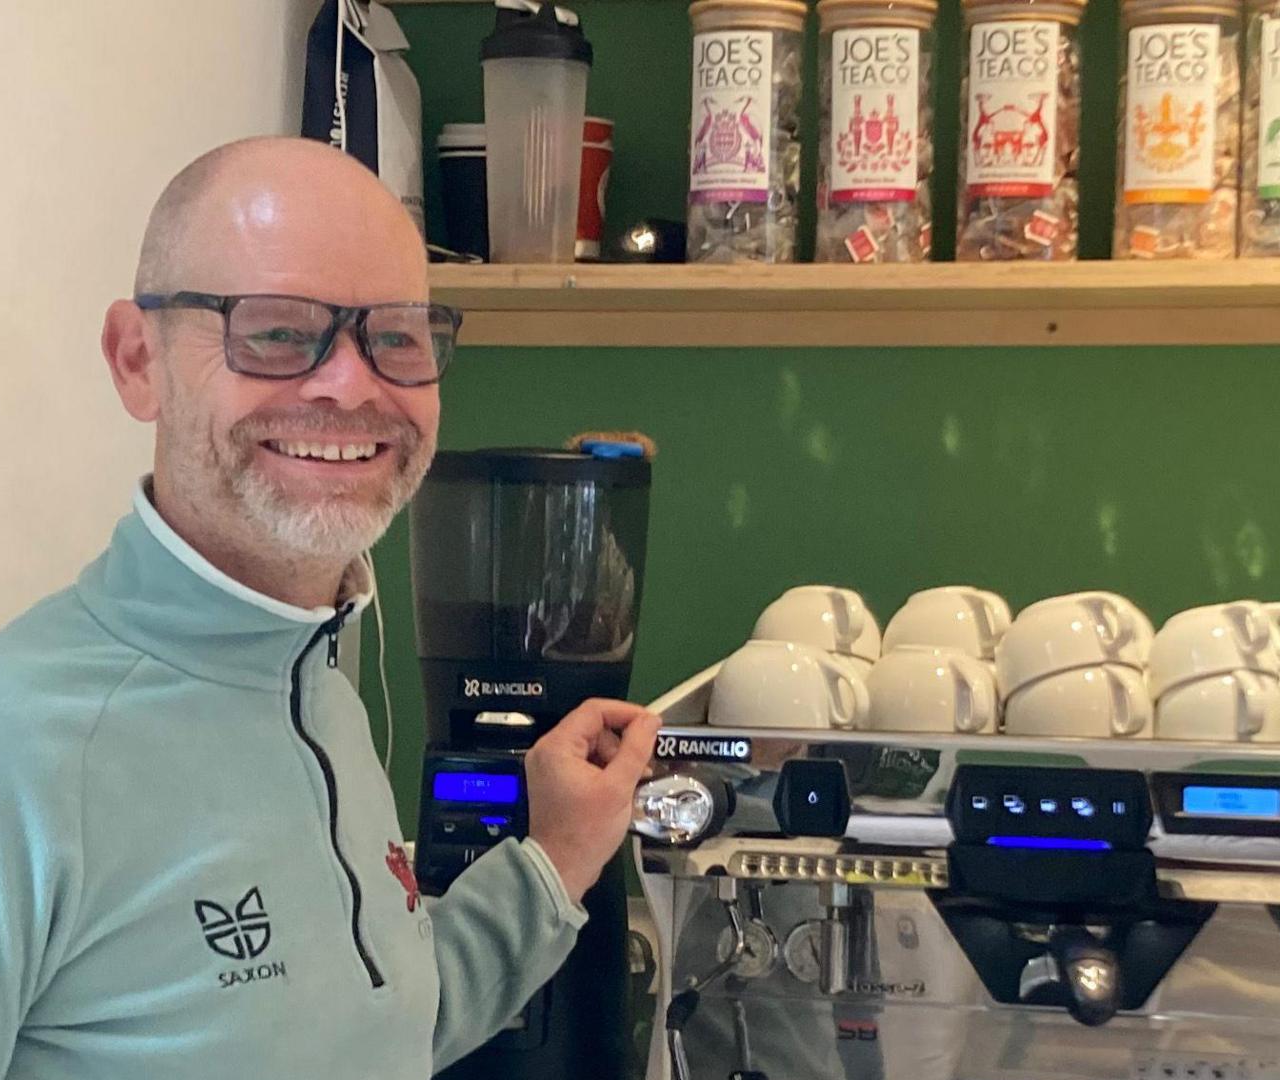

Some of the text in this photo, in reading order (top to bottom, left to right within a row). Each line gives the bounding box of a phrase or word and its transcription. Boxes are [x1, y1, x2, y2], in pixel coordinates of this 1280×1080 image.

[698, 35, 763, 66] JOE'S
[839, 35, 910, 65] JOE'S
[976, 26, 1050, 57] JOE'S
[1135, 28, 1209, 62] JOE'S
[481, 681, 543, 697] RANCILIO
[678, 739, 749, 758] RANCILIO
[218, 960, 287, 989] SAXON
